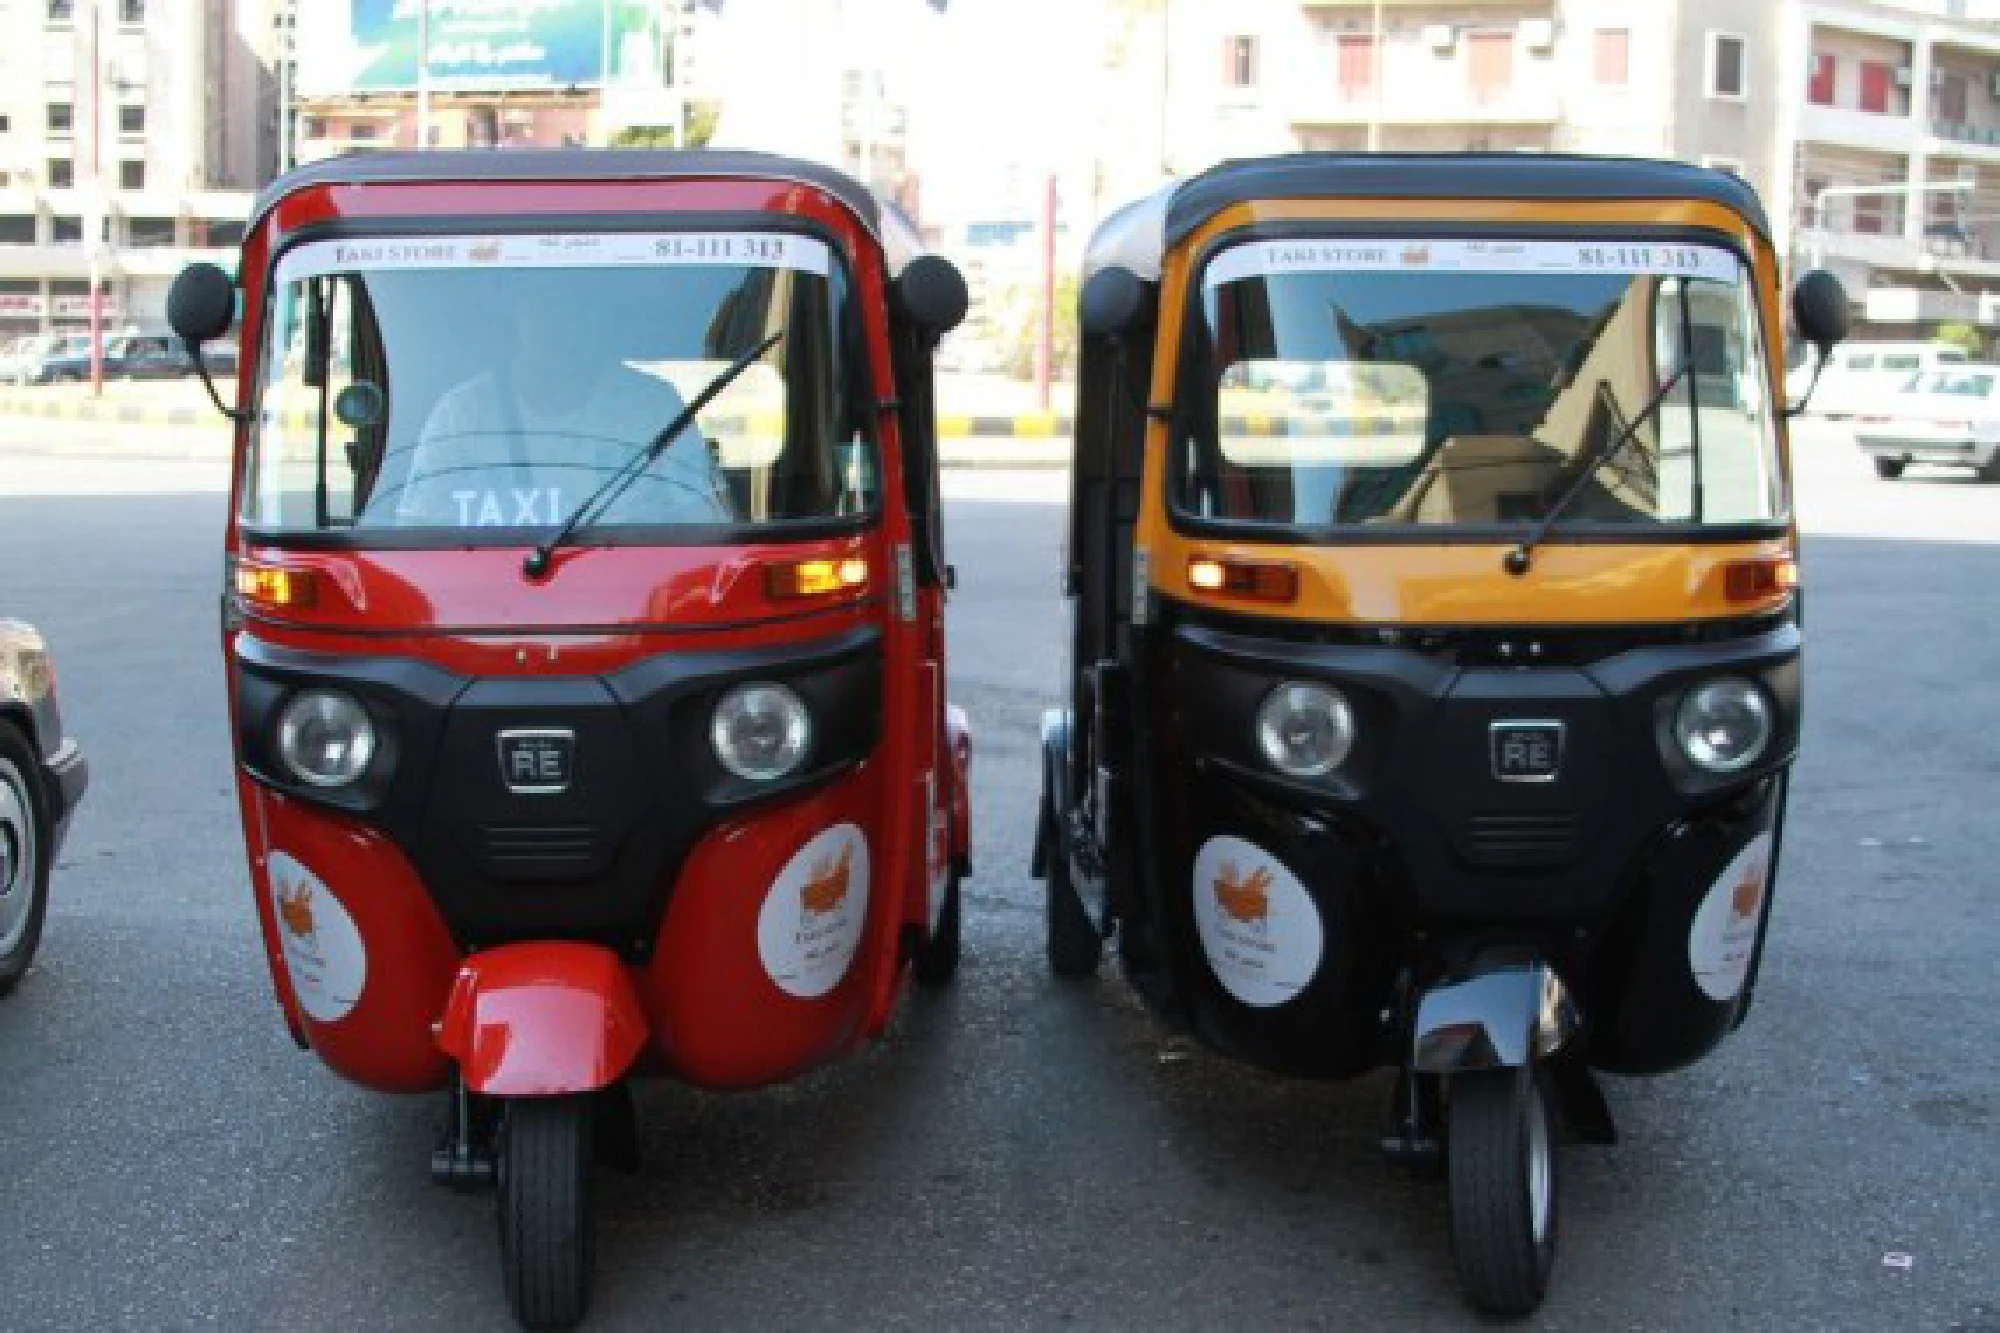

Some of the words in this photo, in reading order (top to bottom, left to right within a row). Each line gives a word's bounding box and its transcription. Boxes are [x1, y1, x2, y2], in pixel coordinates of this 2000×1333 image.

[388, 245, 455, 262] STORE
[654, 238, 731, 257] 81-111
[742, 238, 786, 260] 313
[1321, 247, 1387, 263] STORE
[452, 488, 561, 526] TAXI
[511, 749, 561, 779] RE
[1502, 742, 1551, 769] RE
